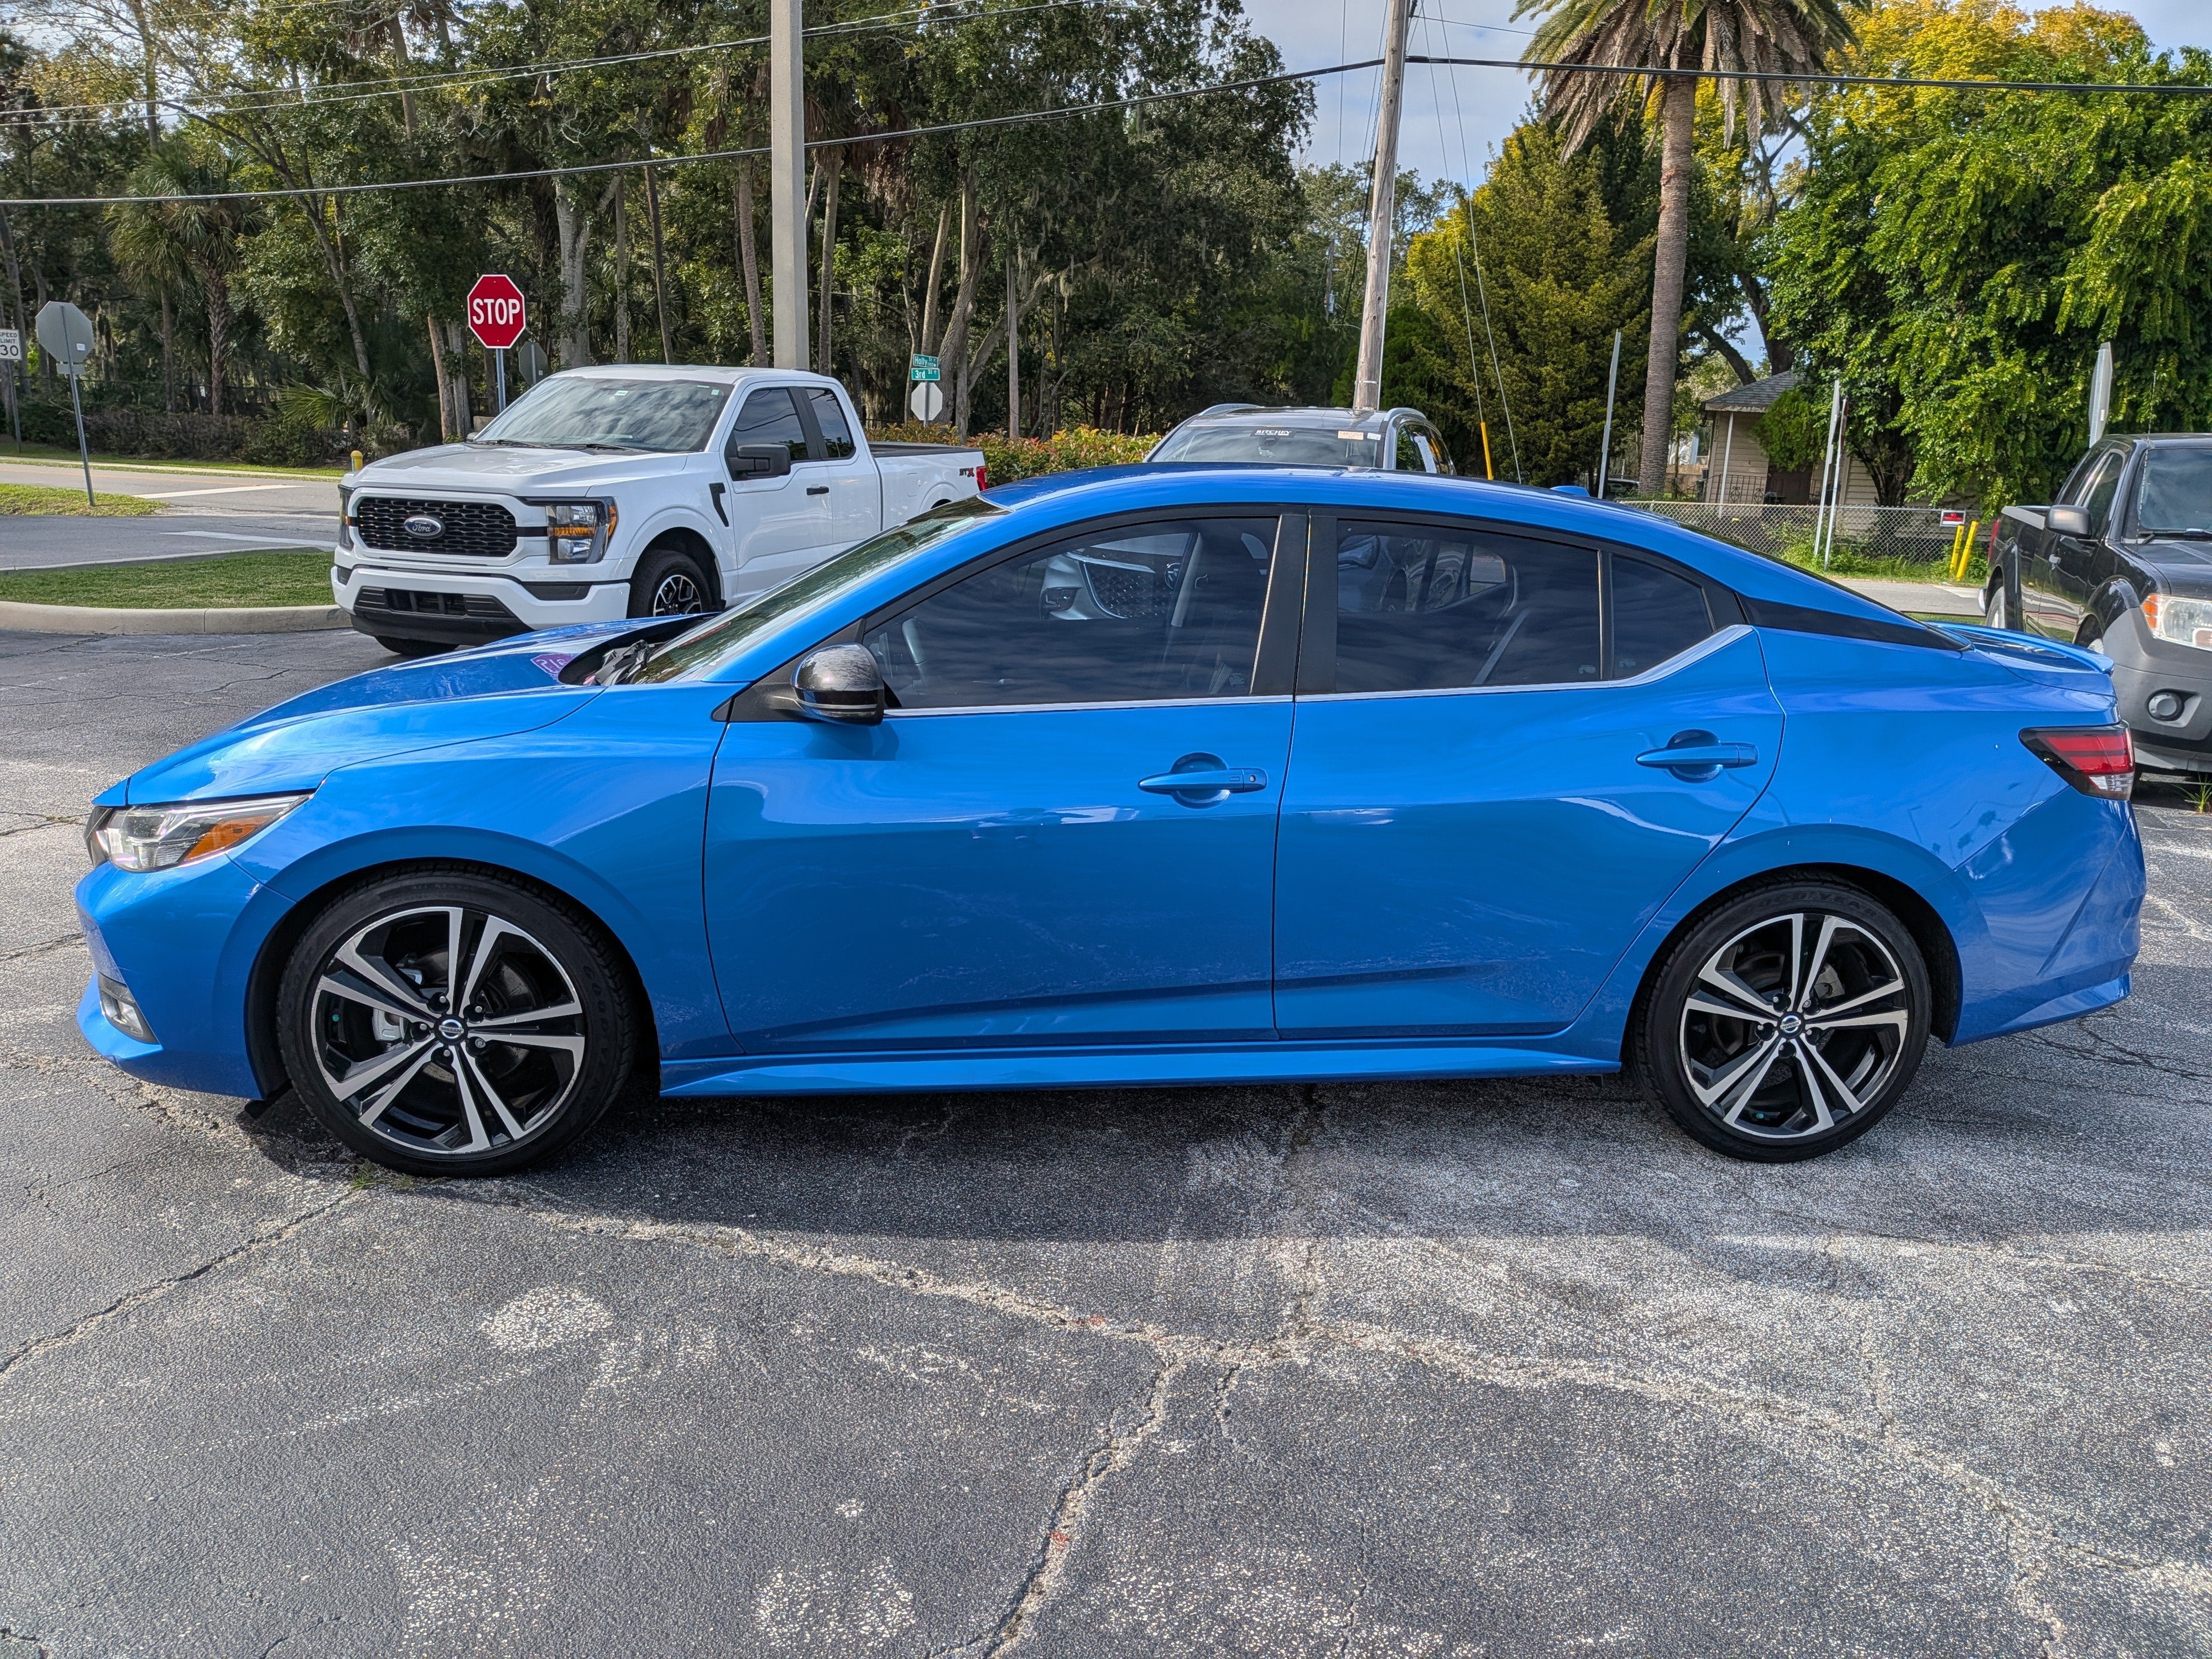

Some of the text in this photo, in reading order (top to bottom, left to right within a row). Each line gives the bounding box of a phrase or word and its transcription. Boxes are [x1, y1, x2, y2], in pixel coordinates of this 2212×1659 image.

[472, 298, 520, 325] STOP
[0, 345, 19, 356] 30
[915, 356, 927, 366] Holly
[915, 369, 925, 379] 3rd
[412, 521, 431, 531] Ford
